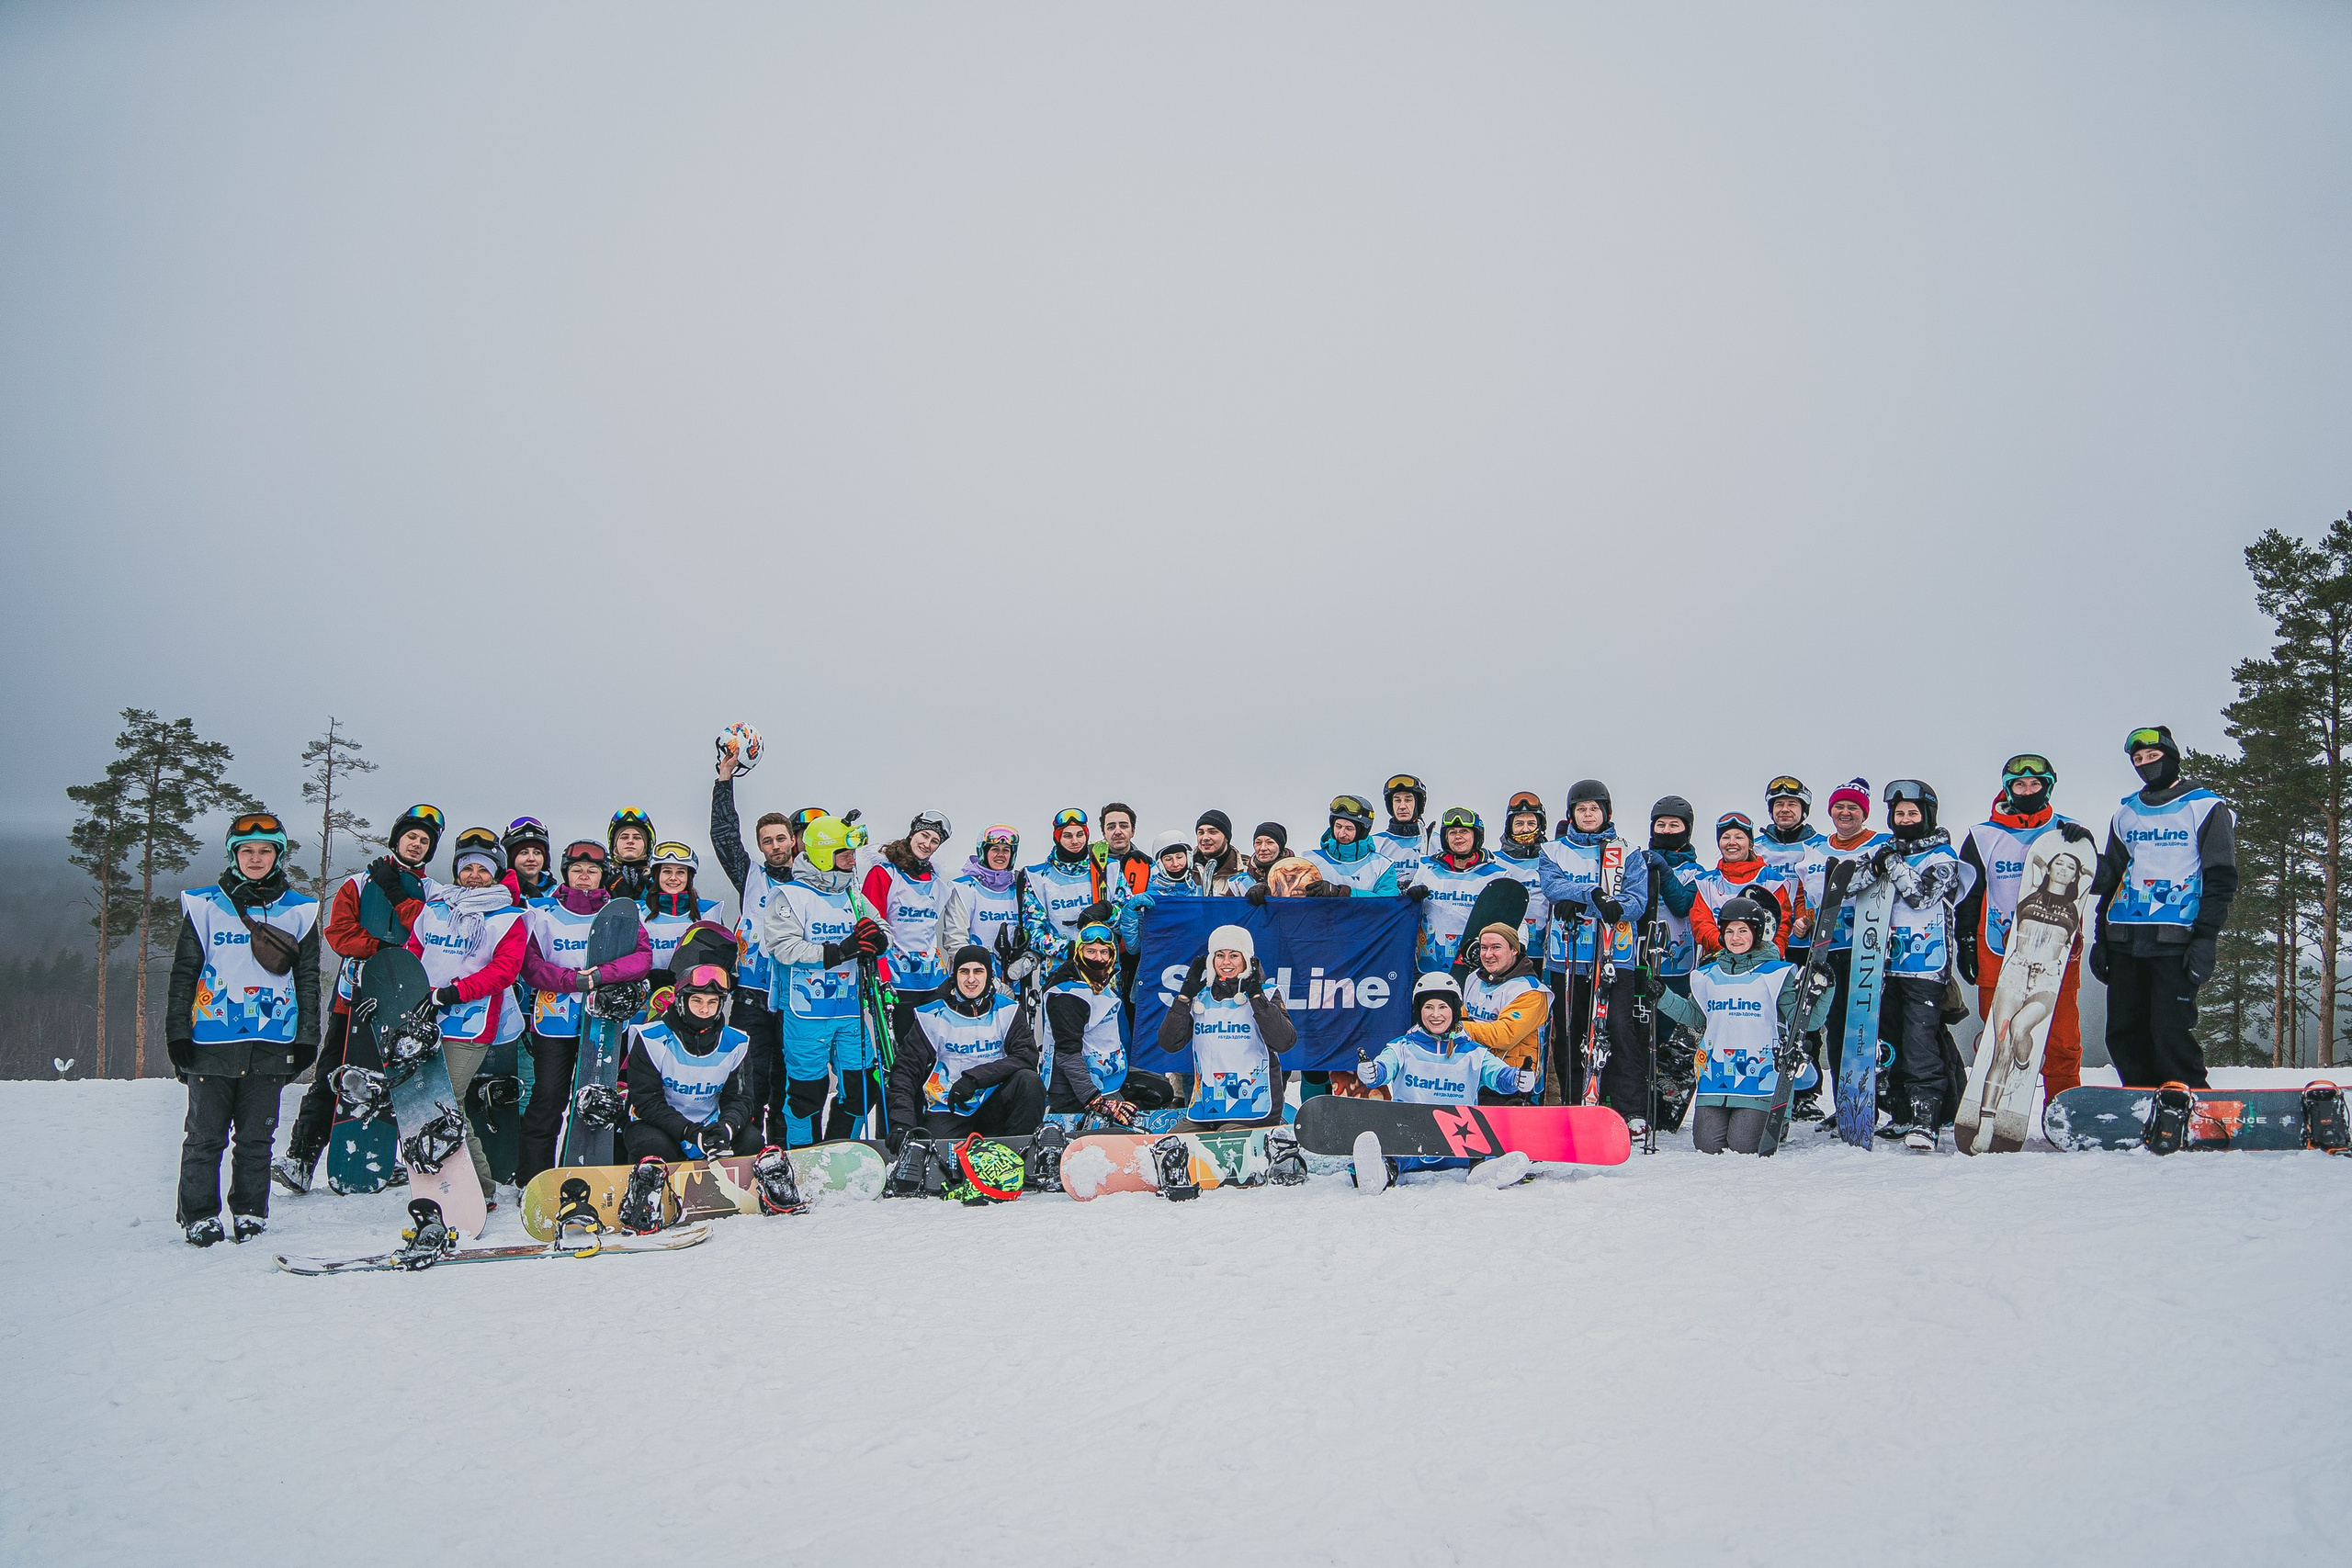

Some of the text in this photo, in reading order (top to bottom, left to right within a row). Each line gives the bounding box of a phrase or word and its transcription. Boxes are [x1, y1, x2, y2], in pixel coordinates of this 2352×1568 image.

[2125, 828, 2189, 843] StarLine
[1050, 894, 1093, 910] StarLi
[811, 921, 854, 935] StarLi
[213, 931, 251, 946] Star
[553, 938, 587, 952] Star
[1856, 910, 1881, 1012] JOINT
[1707, 998, 1762, 1012] StarLine
[1194, 1021, 1251, 1035] StarLine
[1405, 1074, 1465, 1093] StarLine
